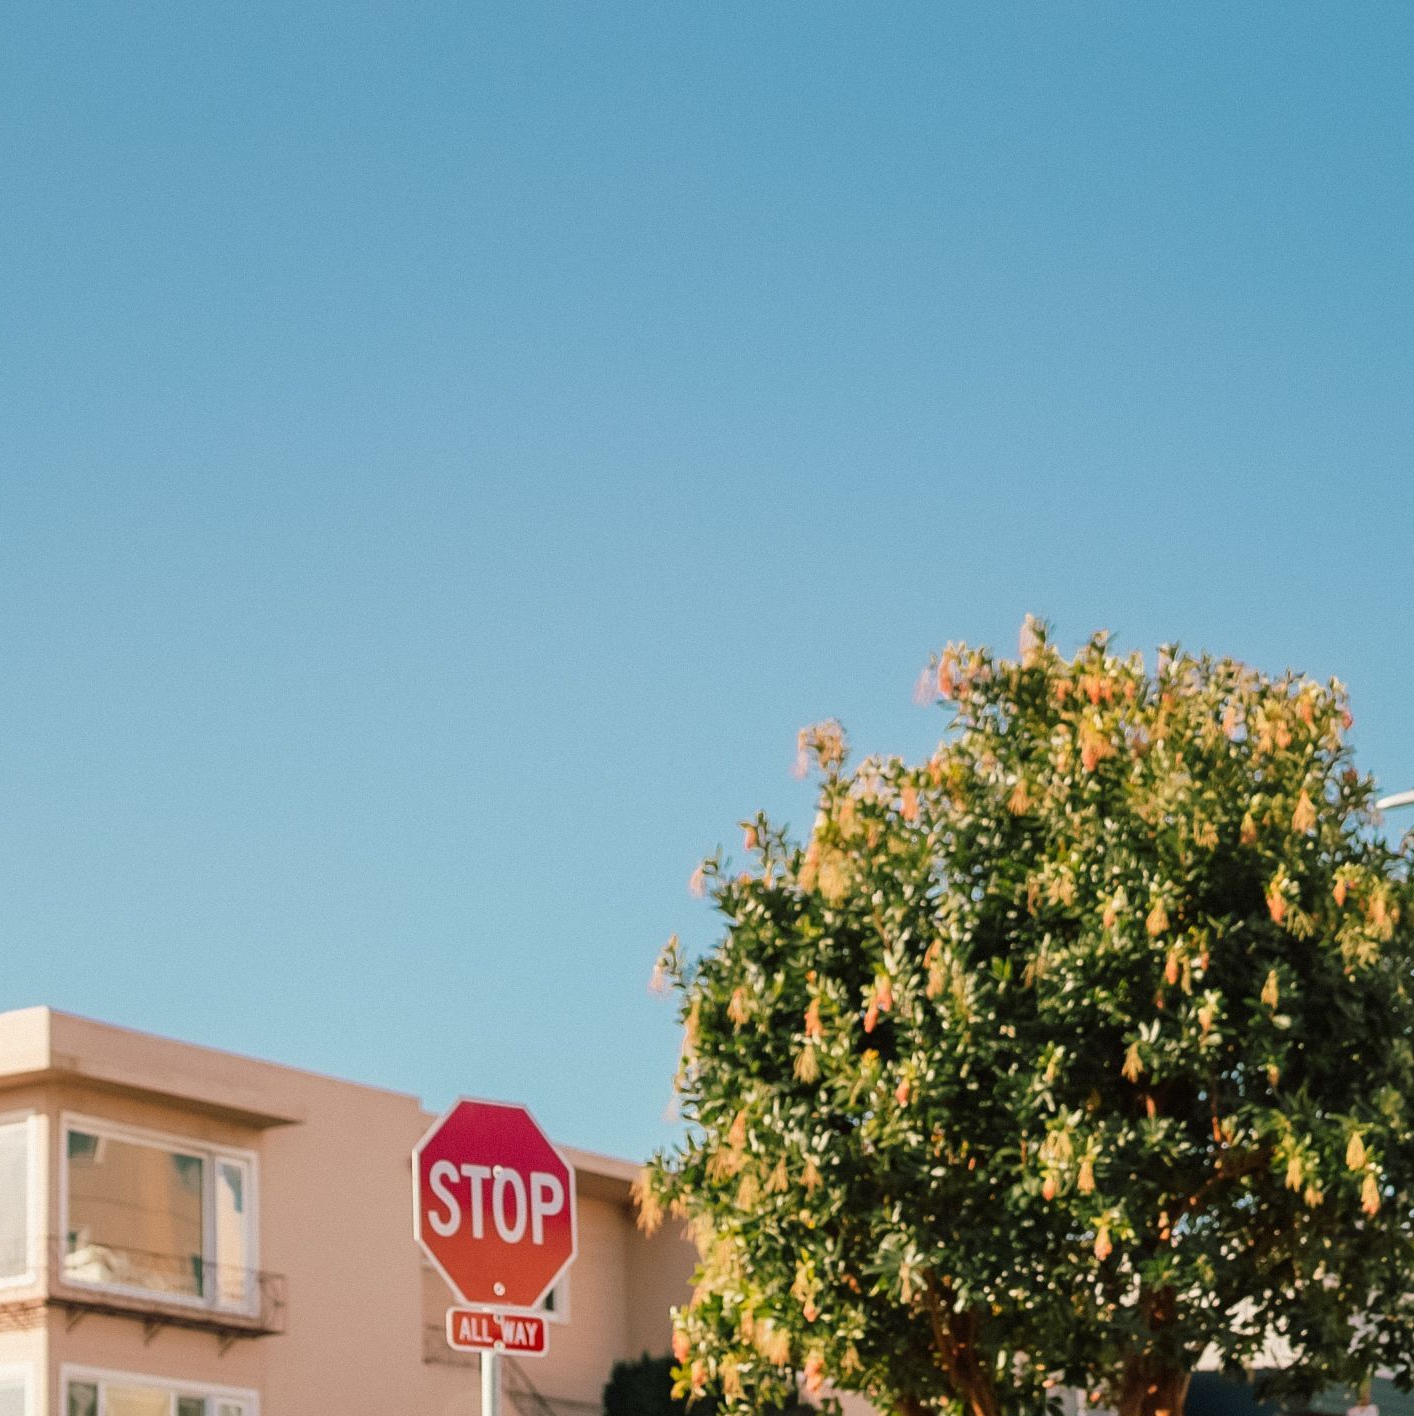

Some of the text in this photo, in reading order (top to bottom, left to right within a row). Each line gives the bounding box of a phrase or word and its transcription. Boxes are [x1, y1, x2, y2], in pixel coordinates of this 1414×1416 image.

[428, 1160, 564, 1245] STOP
[458, 1316, 538, 1347] ALL WAY
